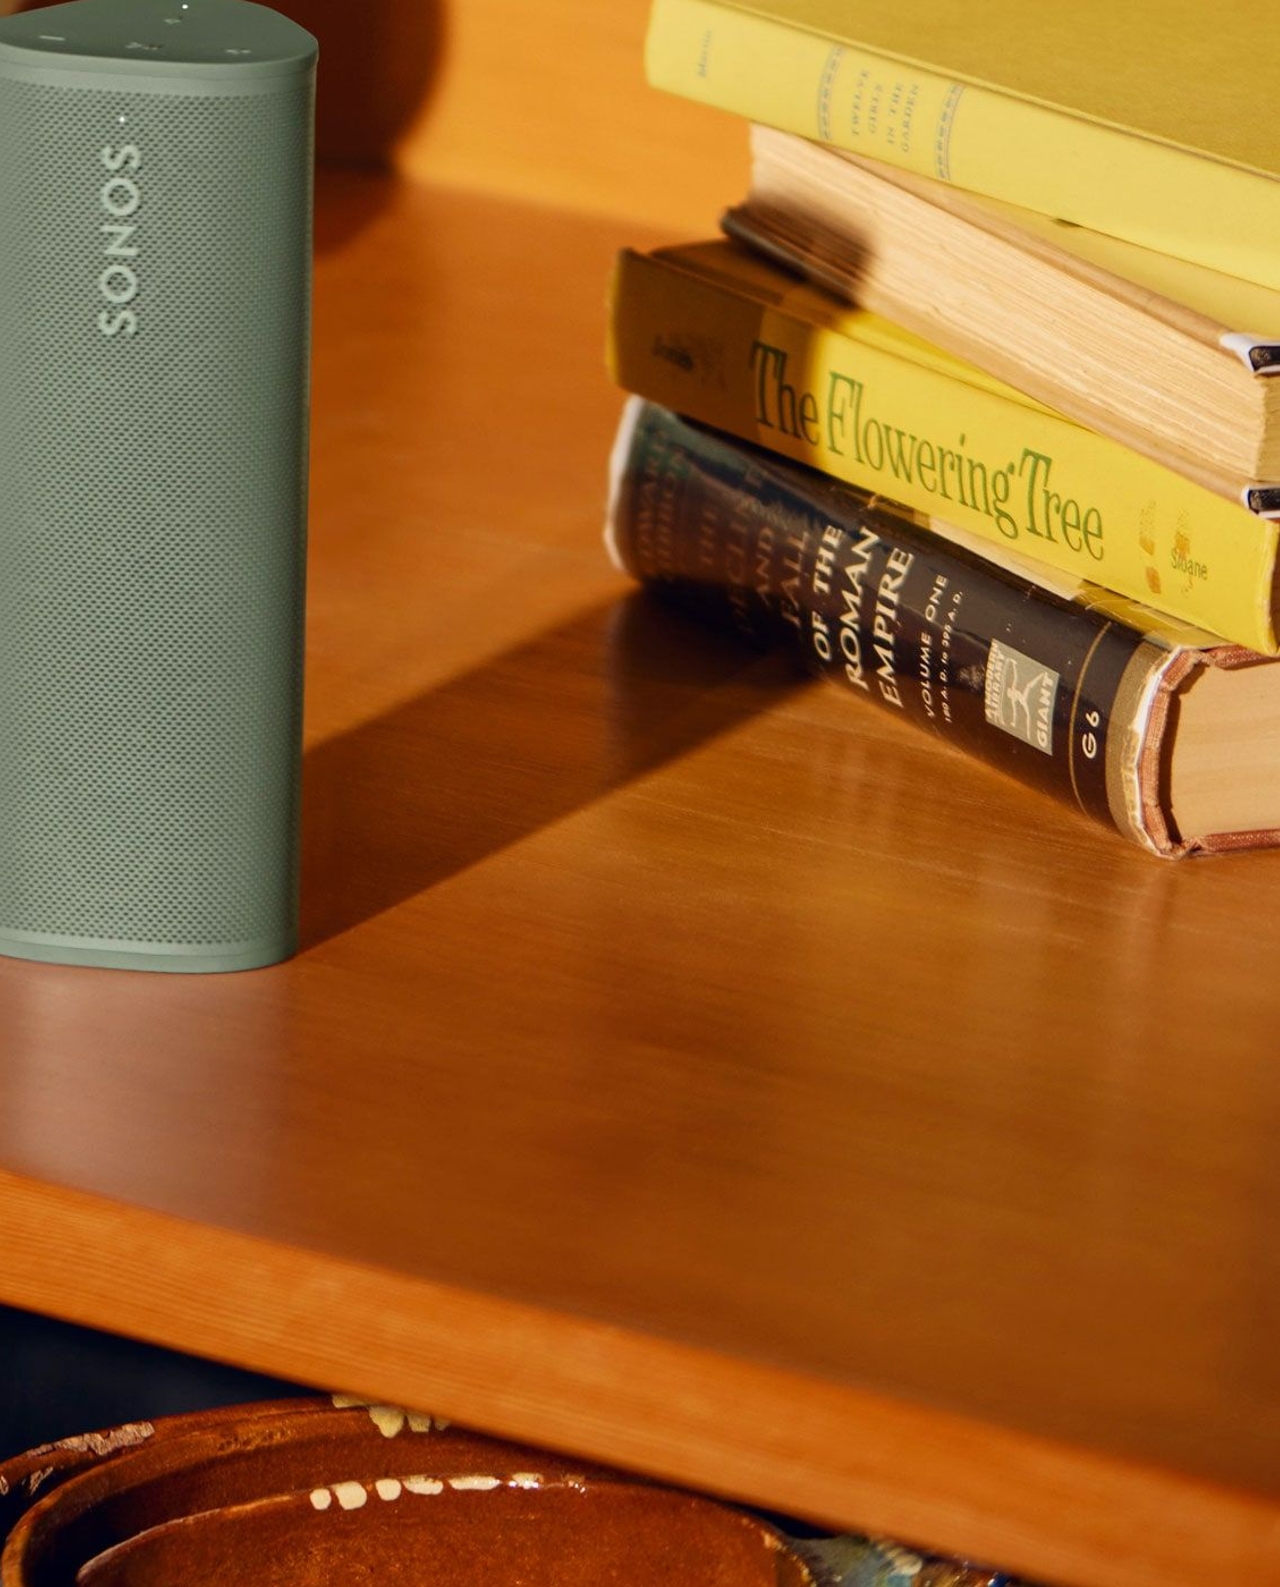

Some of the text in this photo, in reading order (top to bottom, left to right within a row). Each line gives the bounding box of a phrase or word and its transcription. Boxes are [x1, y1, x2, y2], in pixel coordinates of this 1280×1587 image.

[890, 81, 904, 116] THE
[901, 83, 920, 153] GARDEN
[97, 144, 142, 337] SONOS
[749, 339, 1105, 561] The Flowering Tree
[780, 530, 810, 628] FALL
[811, 524, 843, 662] OF THE
[839, 526, 882, 692] ROMAN
[1170, 546, 1209, 581] Sloane
[872, 547, 915, 709] EMPIRE
[918, 574, 949, 718] VOLUME ONE
[985, 642, 998, 706] MODERN
[1037, 671, 1054, 748] GIANT
[1082, 711, 1100, 759] G 6
